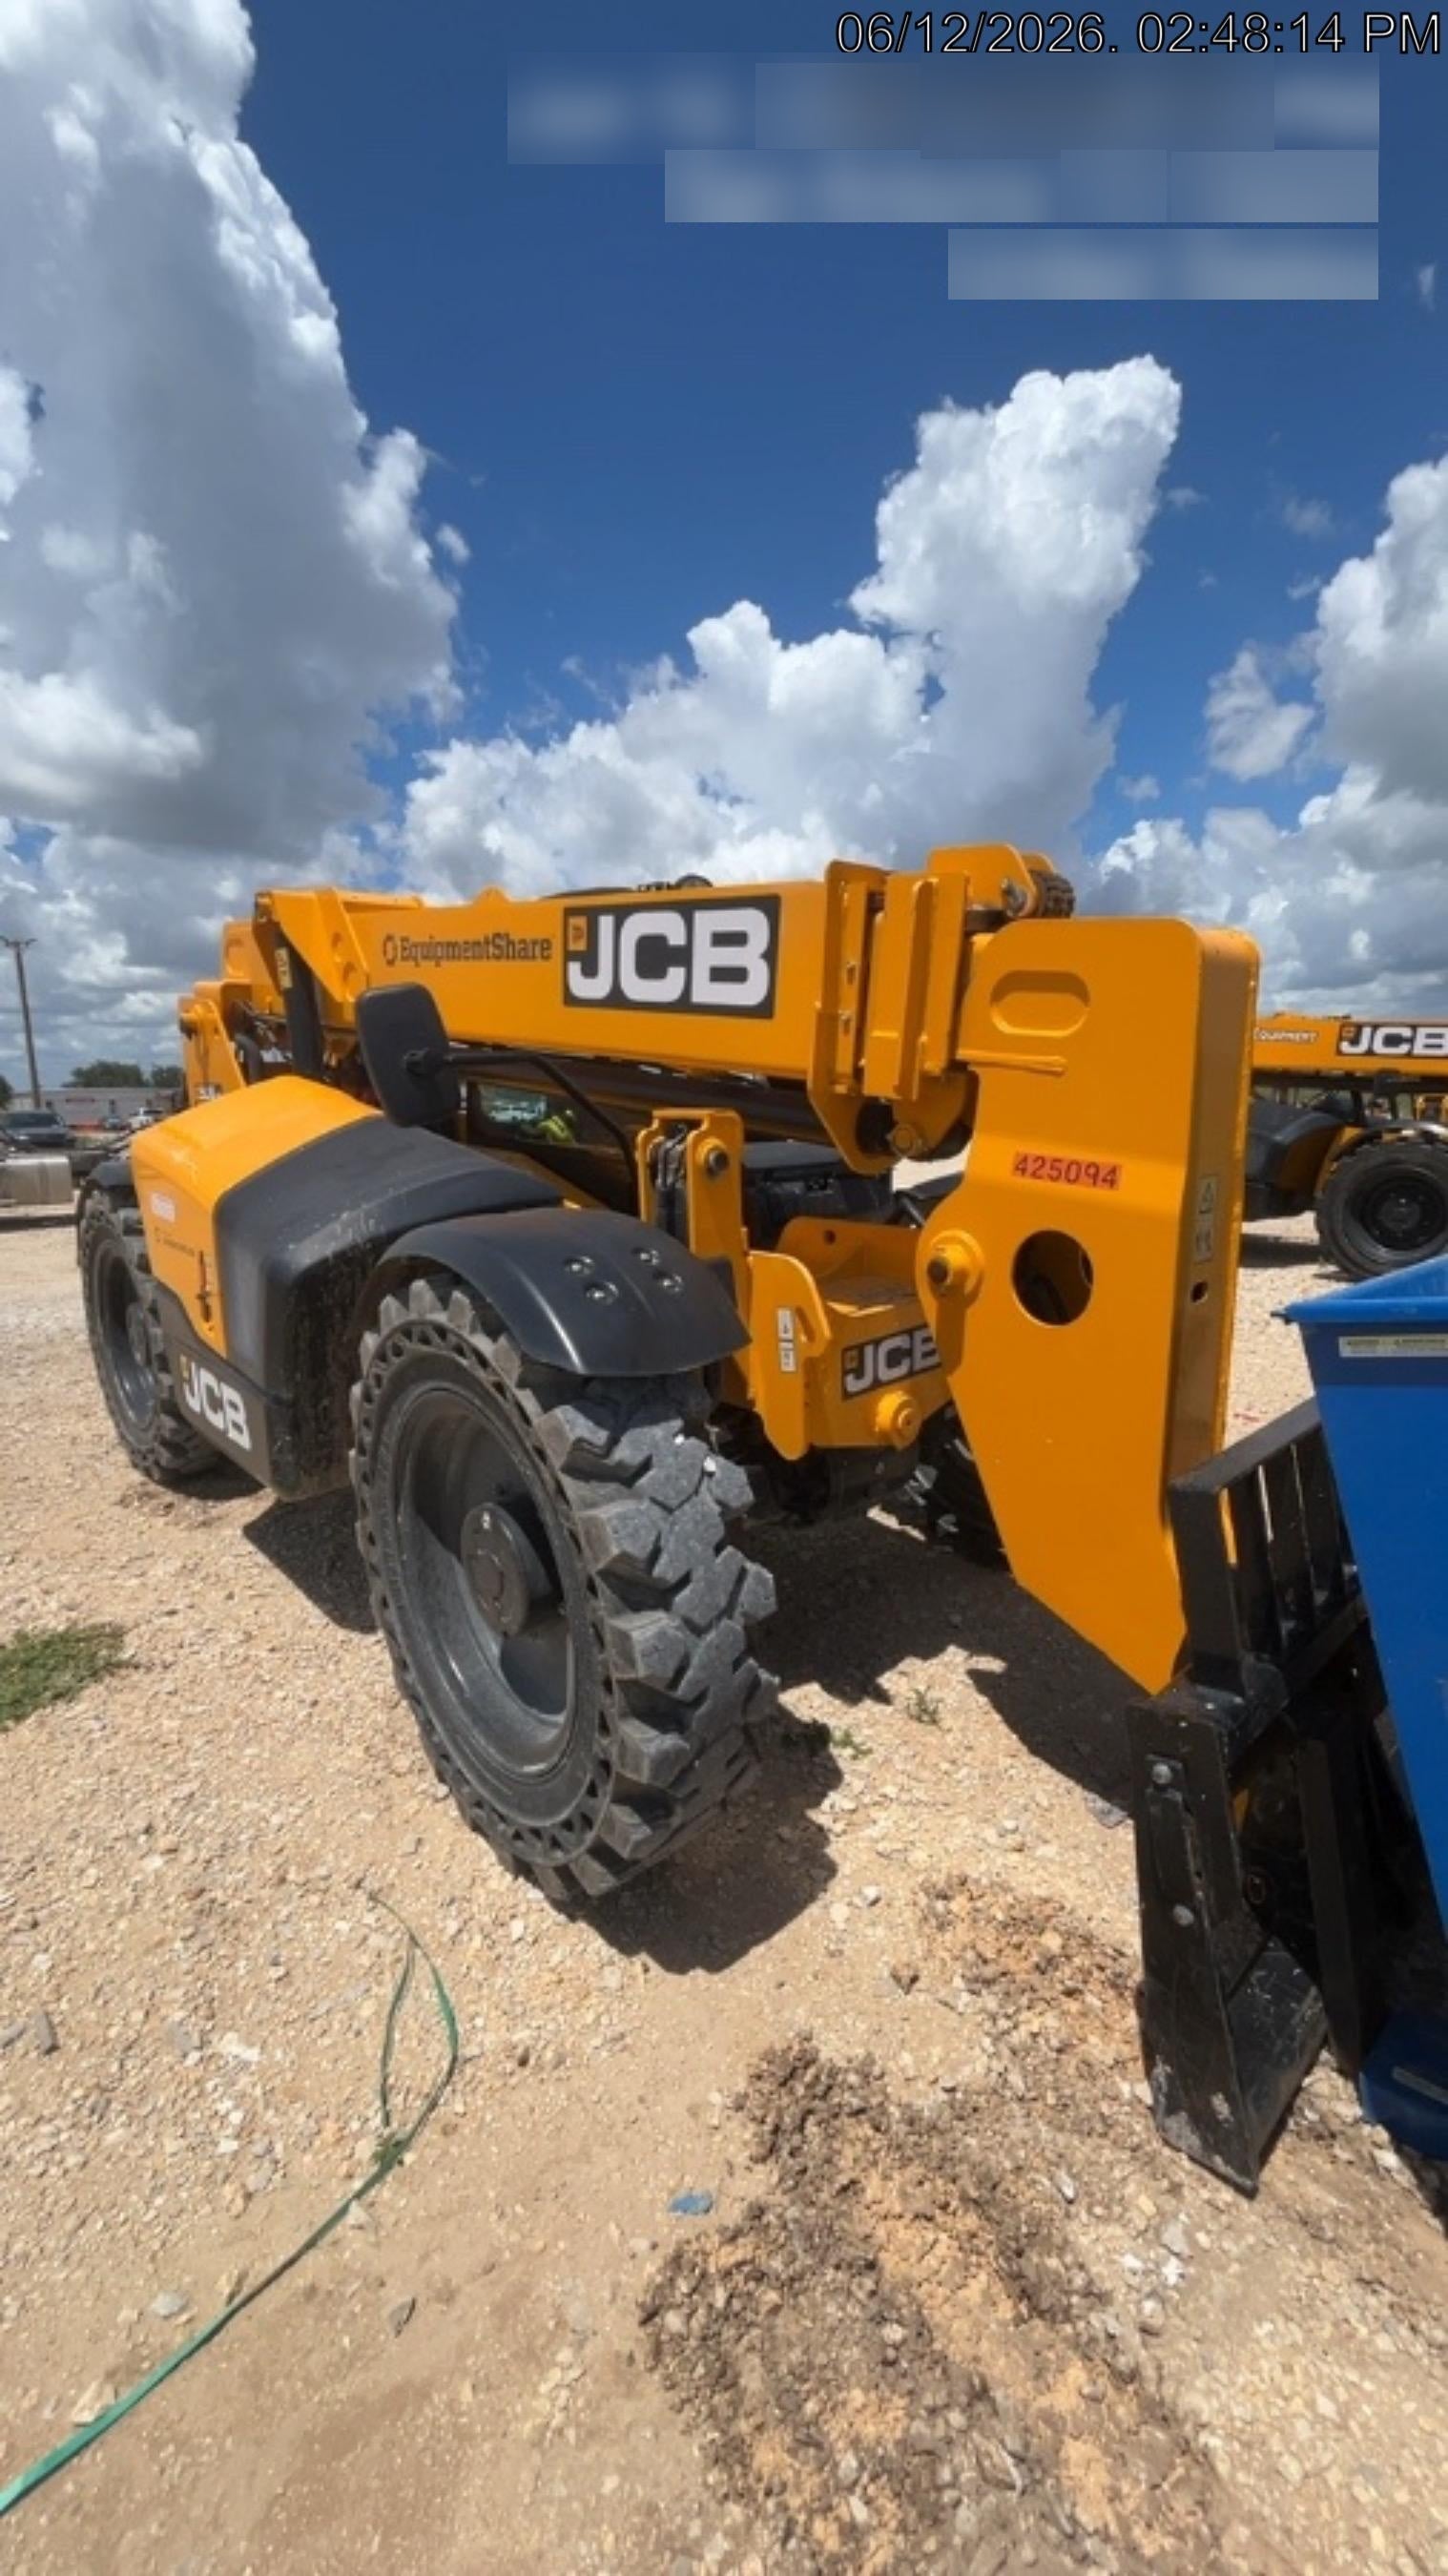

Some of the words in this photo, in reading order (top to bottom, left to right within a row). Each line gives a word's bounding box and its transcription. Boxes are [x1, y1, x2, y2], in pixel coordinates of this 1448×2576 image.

[400, 932, 553, 967] EquipmentShare
[567, 907, 771, 1006] JCB
[1339, 1026, 1448, 1056] JCB
[1014, 1153, 1118, 1189] 425094
[182, 1361, 252, 1450] JCB
